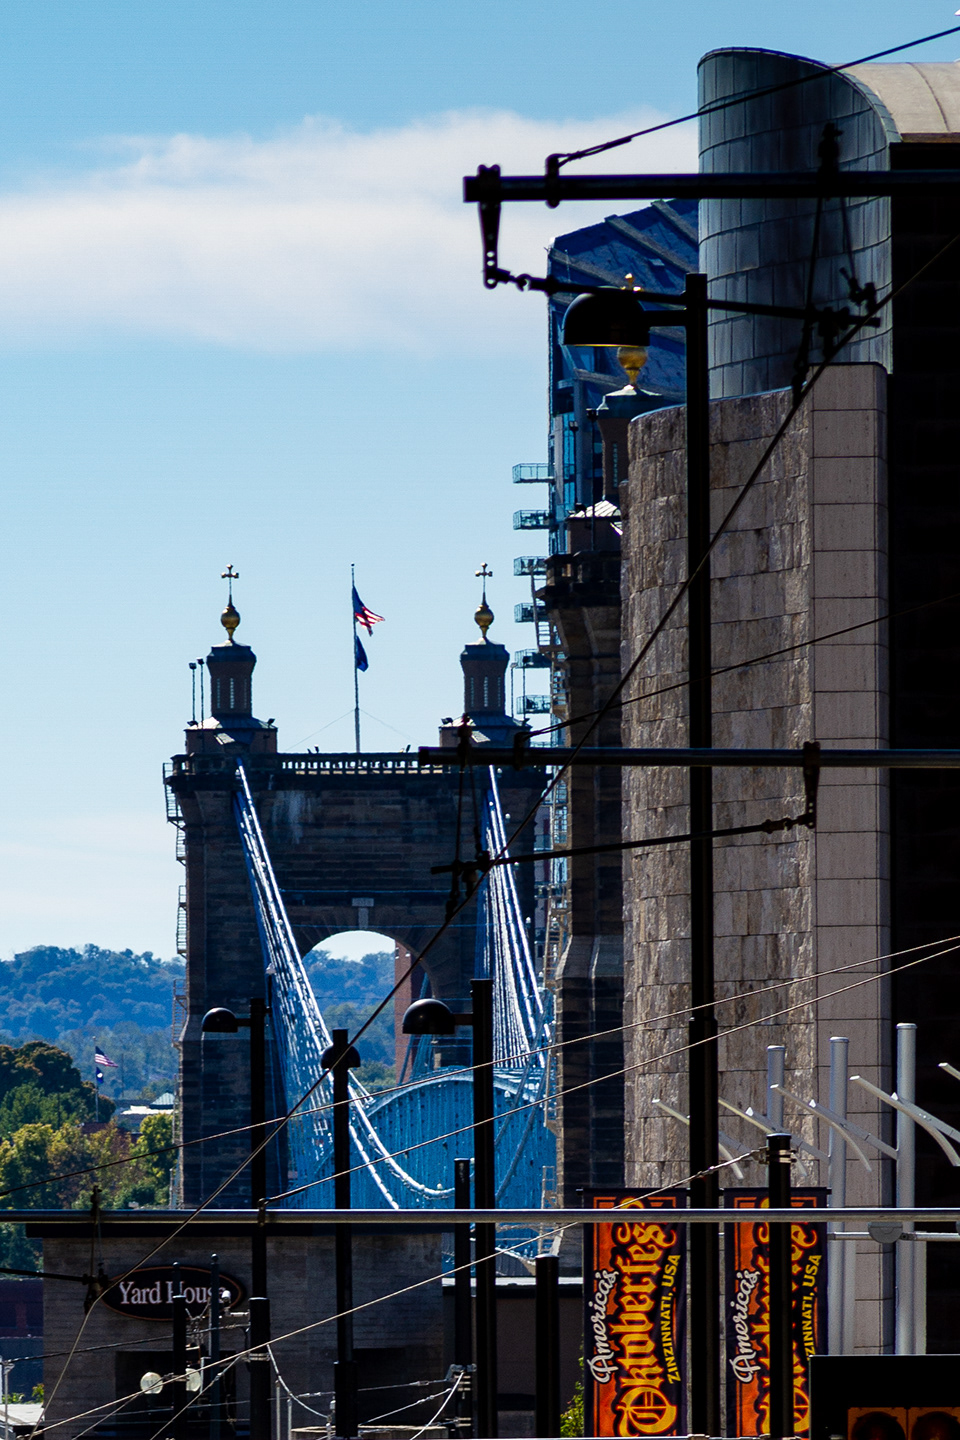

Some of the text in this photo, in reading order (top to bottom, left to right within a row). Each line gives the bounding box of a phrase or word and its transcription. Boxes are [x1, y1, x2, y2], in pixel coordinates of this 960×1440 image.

[120, 1281, 162, 1304] Yard
[587, 1269, 619, 1382] America's
[660, 1254, 681, 1384] ZINZINNATI, USA
[729, 1269, 760, 1382] America's
[801, 1254, 822, 1356] ZINNATI, USA
